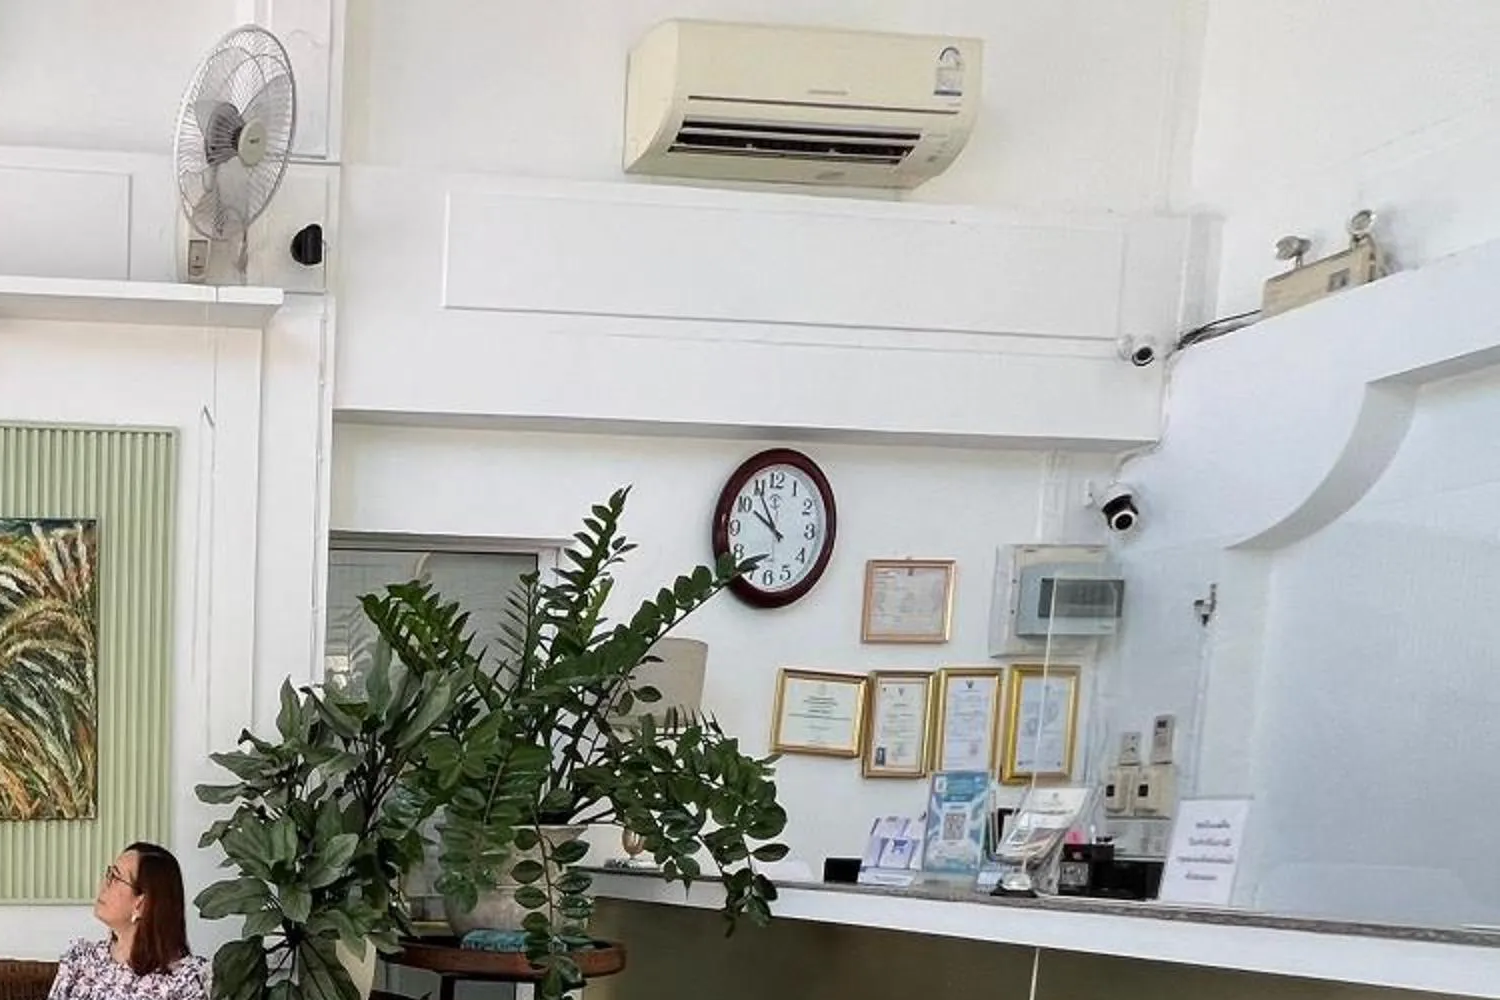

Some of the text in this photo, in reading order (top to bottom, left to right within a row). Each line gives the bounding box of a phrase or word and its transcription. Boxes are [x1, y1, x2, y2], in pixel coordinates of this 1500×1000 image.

[753, 479, 765, 496] 11
[770, 472, 785, 490] 12
[792, 480, 797, 497] 1
[738, 496, 752, 513] 10
[802, 499, 812, 516] 2
[729, 519, 740, 536] 9
[804, 523, 815, 540] 3
[734, 543, 744, 560] 8
[794, 547, 805, 564] 4
[763, 570, 773, 586] 6
[780, 564, 791, 581] 5
